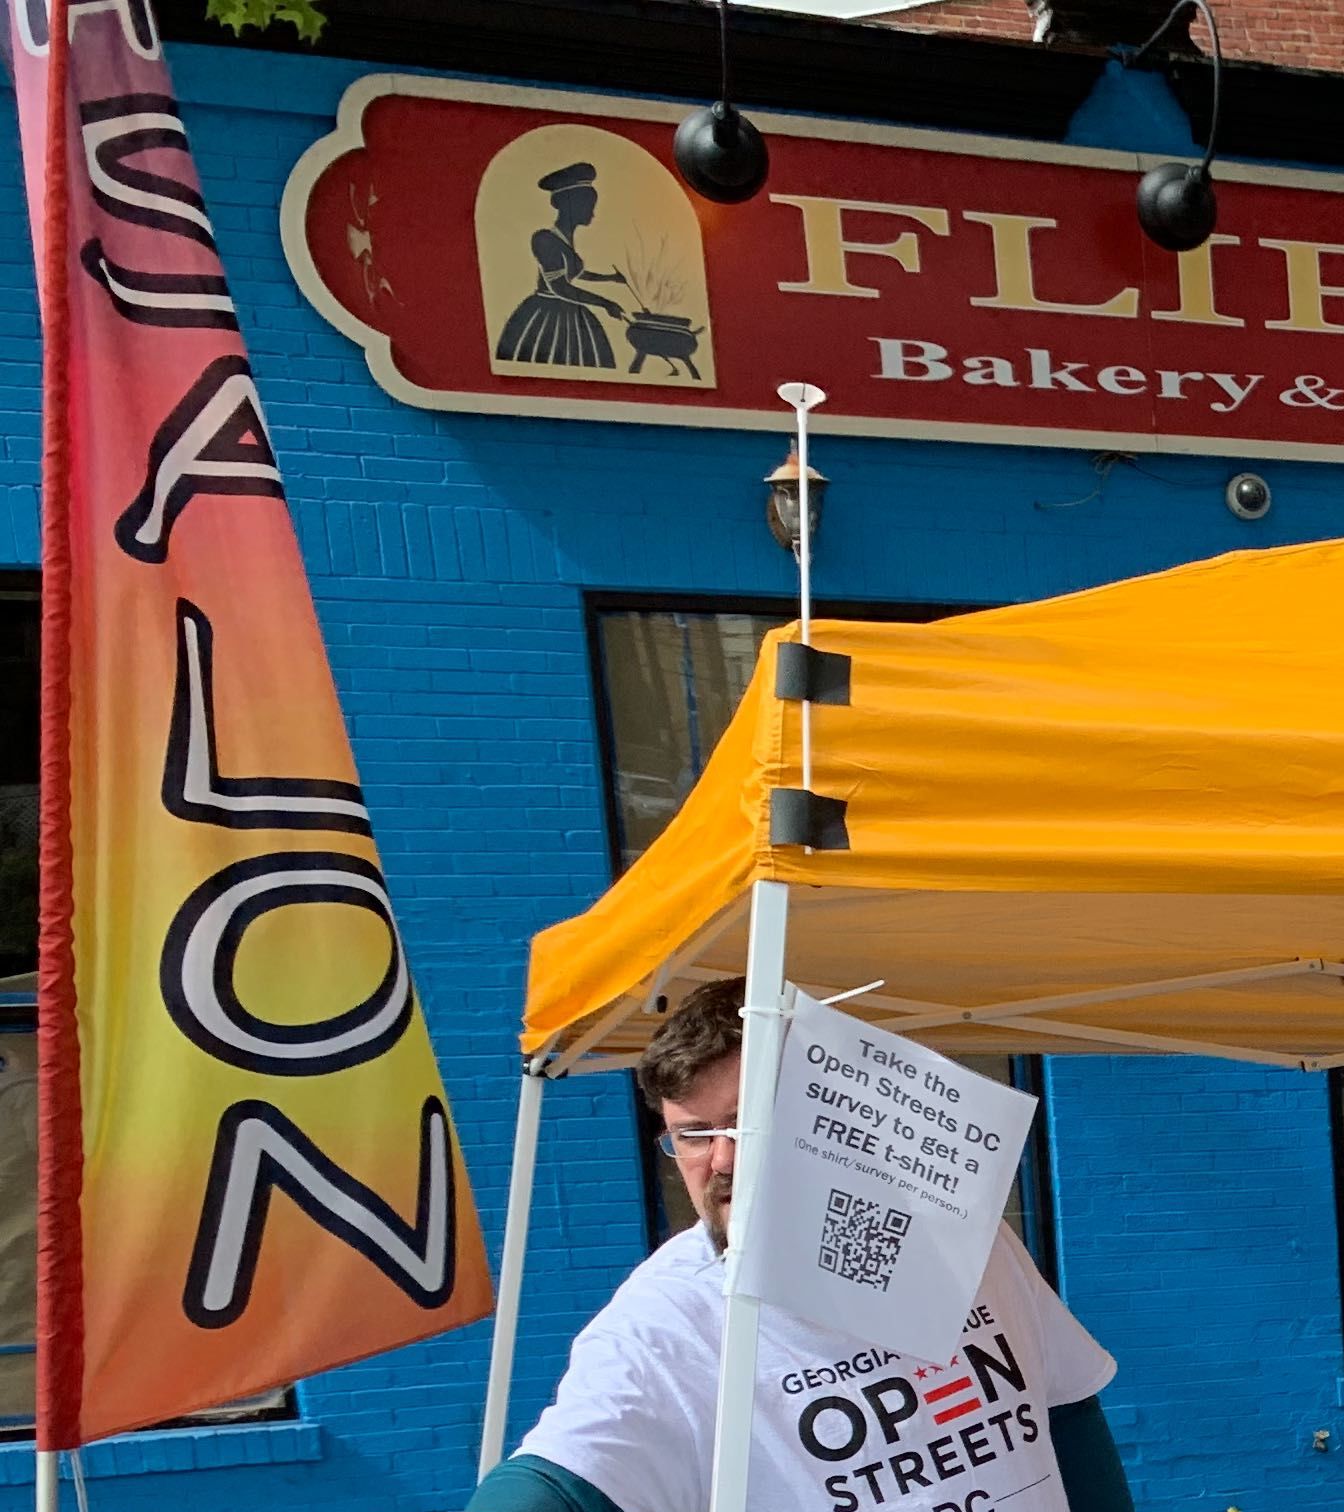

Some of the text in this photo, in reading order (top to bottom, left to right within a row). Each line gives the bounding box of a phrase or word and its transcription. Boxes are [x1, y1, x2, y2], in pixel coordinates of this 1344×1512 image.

[868, 336, 1264, 413] Bakery
[807, 1044, 1001, 1152] Open Streets DC
[859, 1039, 961, 1103] Take the
[806, 1082, 979, 1175] survey to get a
[812, 1114, 960, 1195] FREE t-shirt!
[898, 1179, 919, 1193] per
[920, 1190, 969, 1220] person.)
[797, 1333, 1027, 1462] OPEN
